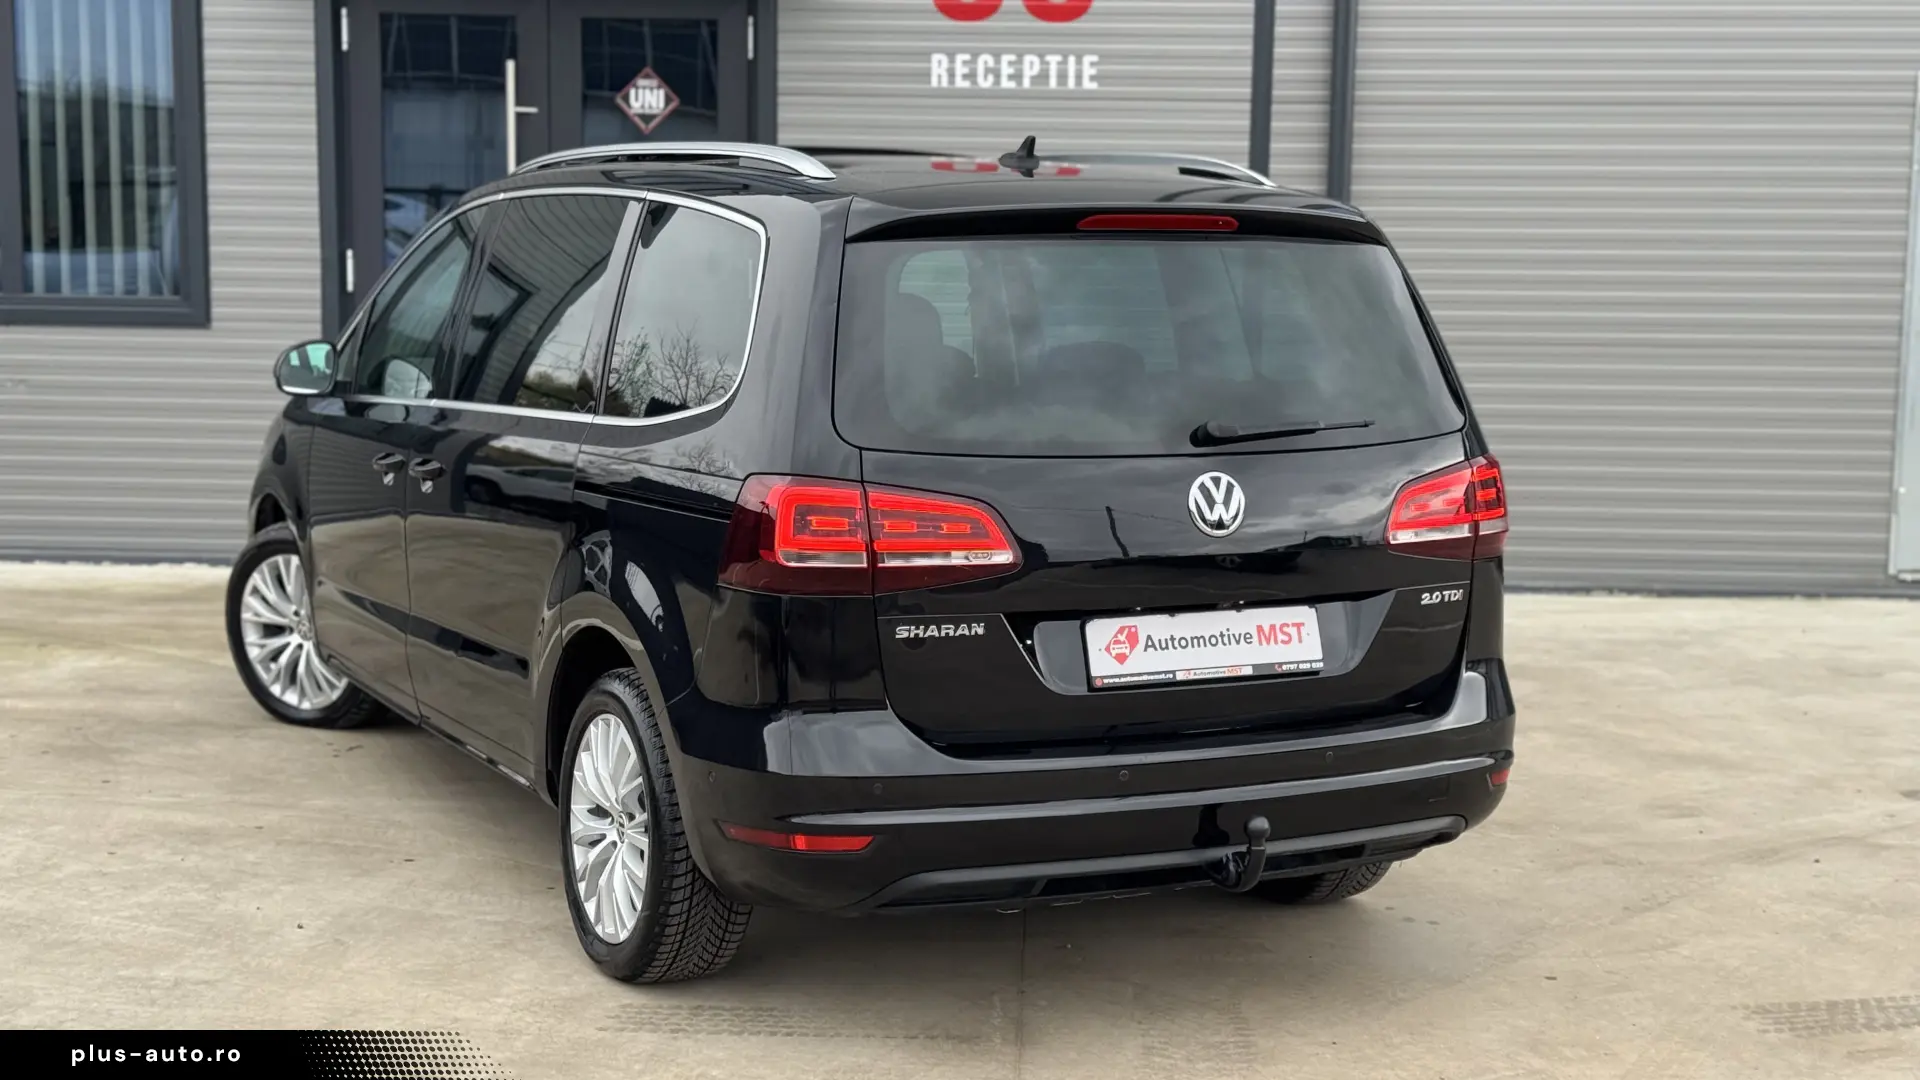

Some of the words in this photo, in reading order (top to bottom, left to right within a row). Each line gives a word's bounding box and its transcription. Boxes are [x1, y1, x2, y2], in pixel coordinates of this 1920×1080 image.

[930, 53, 1100, 90] RECEPTIE
[628, 87, 666, 110] UNI
[1442, 589, 1464, 603] TDI
[895, 622, 985, 639] SHARAN
[1143, 628, 1254, 653] Automotive
[1255, 622, 1306, 647] MST
[1193, 670, 1226, 678] Automotive
[1226, 667, 1243, 676] MST
